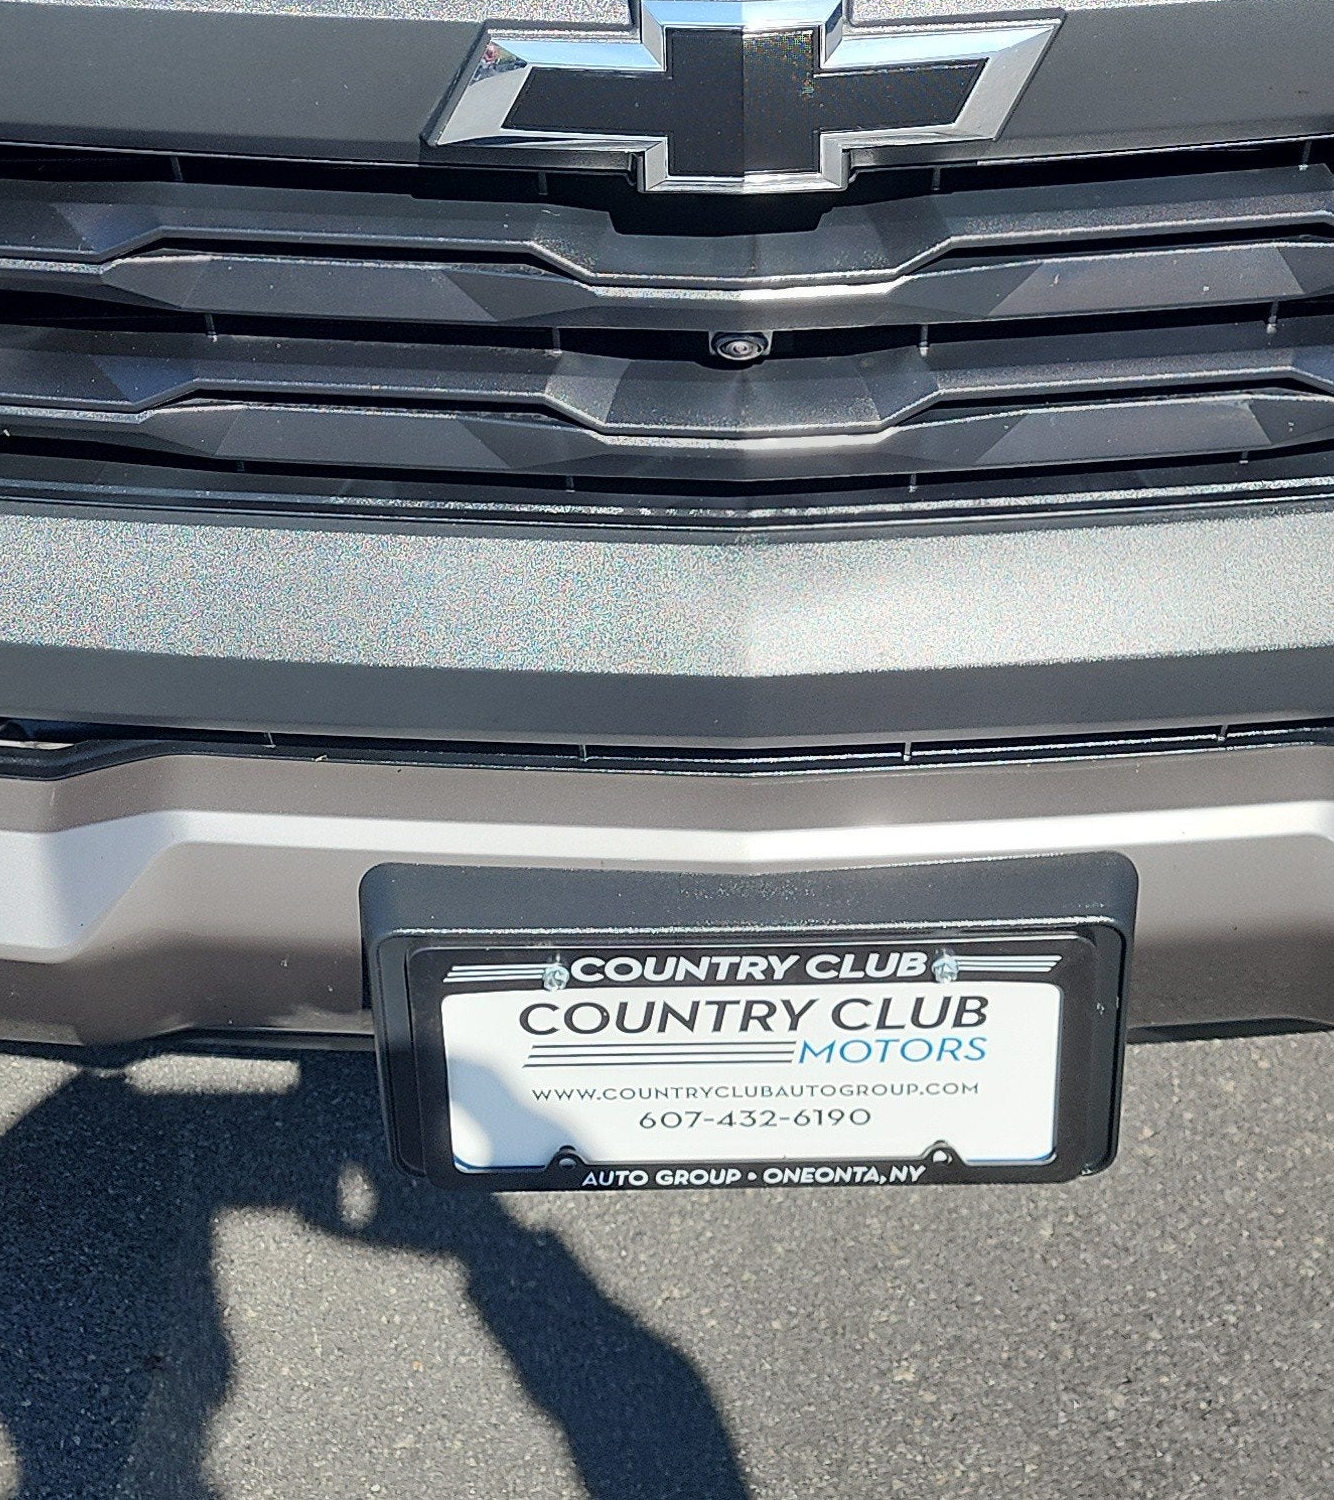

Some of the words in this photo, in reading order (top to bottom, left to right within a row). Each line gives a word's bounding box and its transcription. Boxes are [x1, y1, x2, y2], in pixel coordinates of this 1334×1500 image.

[570, 954, 800, 982] COUNTRY
[805, 951, 928, 979] CLUB
[519, 998, 819, 1035] COUNTRY
[831, 995, 989, 1031] CLUB
[798, 1036, 988, 1064] MOTORS
[532, 1082, 980, 1101] WWW.COUNTRYCLUBAUTOGROUP.COM
[639, 1108, 872, 1129] 607-432-6190
[582, 1169, 650, 1188] AUTO
[655, 1167, 742, 1187] GROUP
